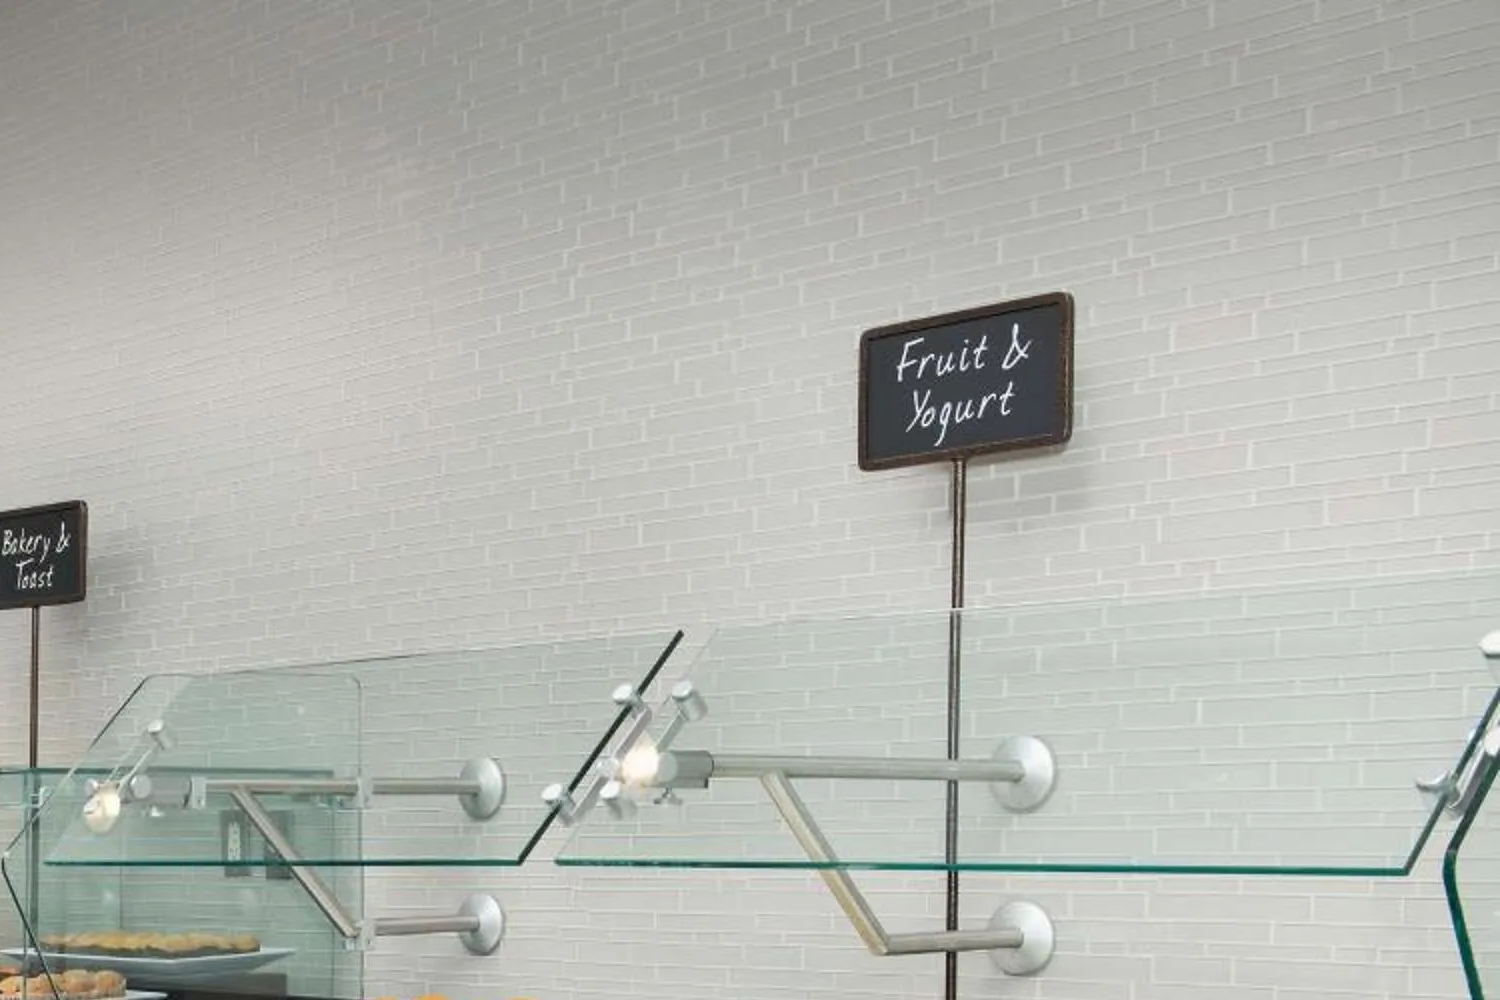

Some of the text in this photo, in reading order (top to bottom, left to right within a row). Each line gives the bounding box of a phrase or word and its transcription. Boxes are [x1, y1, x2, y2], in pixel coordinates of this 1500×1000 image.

[896, 322, 1033, 382] Fruit &
[905, 381, 1016, 447] Yogurt
[1, 521, 72, 563] Bakery &
[15, 557, 54, 590] Toast
